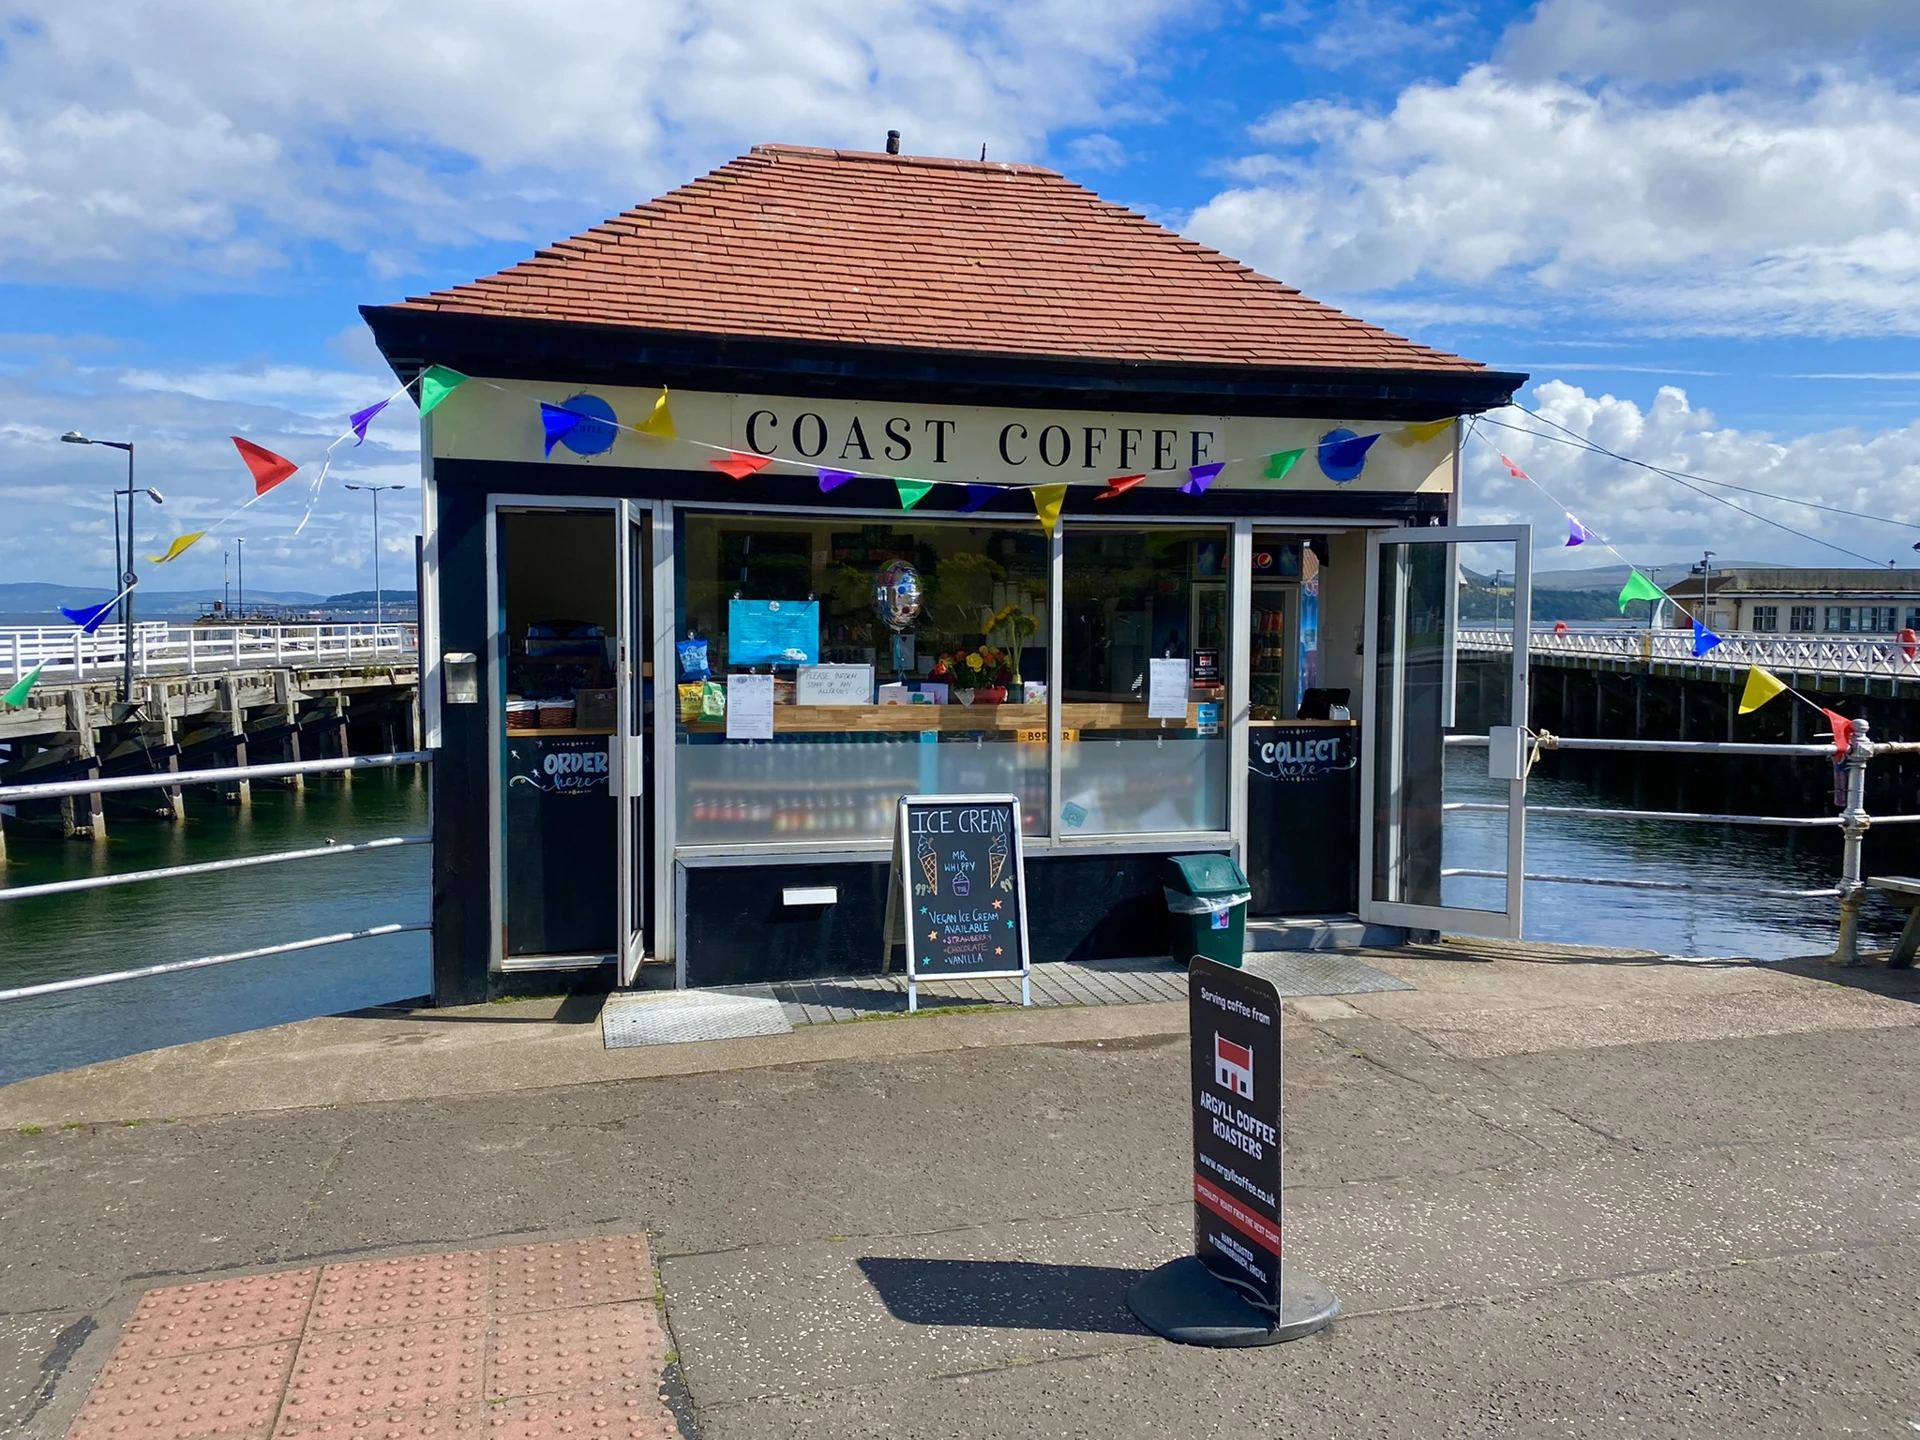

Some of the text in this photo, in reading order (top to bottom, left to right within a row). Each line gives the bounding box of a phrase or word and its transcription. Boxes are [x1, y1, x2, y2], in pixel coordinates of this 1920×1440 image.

[746, 410, 1214, 471] COAST COFFEE
[805, 672, 830, 680] PLEASE
[1261, 738, 1340, 763] COLLECT
[543, 751, 608, 775] ORDER
[911, 809, 1011, 833] ICE CREAM
[944, 861, 976, 872] WHIPPY
[952, 851, 968, 861] MR
[928, 908, 999, 924] VEGAN ICE CREAM
[944, 922, 989, 934] AVAILABLE
[1201, 987, 1271, 1026] Serving coffee from
[1200, 1090, 1276, 1147] ARGYLL COFFEE
[1213, 1117, 1263, 1160] ROASTERS
[1199, 1152, 1276, 1208] www.argyllcoffee.co.uk
